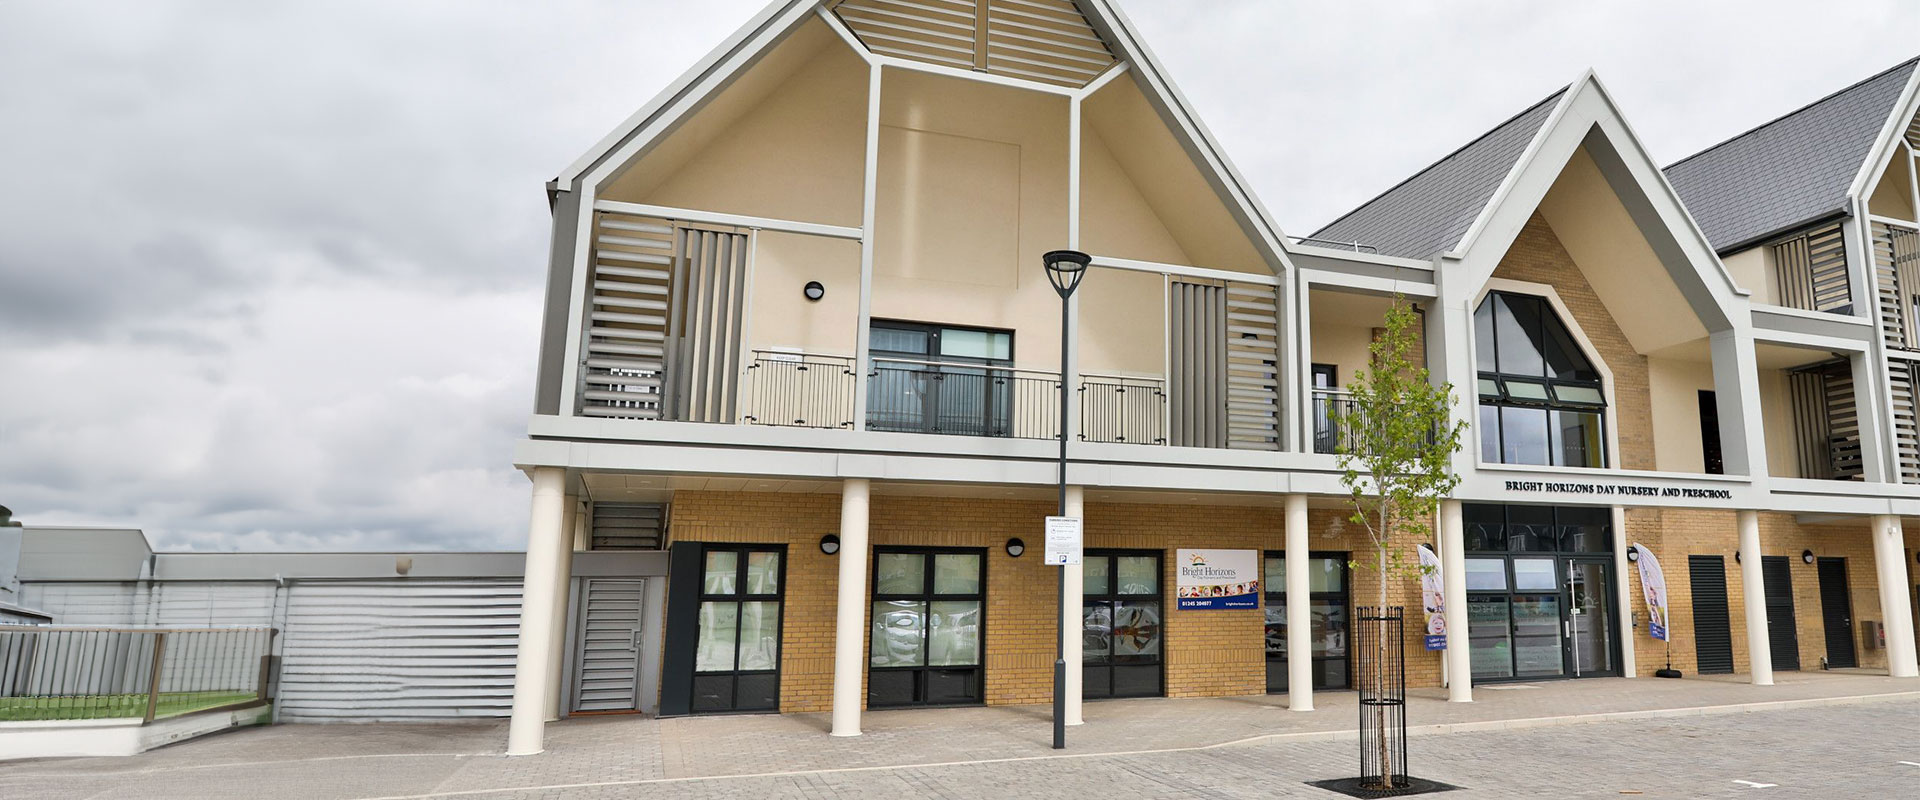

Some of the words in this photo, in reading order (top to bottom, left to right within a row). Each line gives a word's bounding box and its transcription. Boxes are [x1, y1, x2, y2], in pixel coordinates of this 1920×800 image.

[1505, 481, 1543, 492] BRIGHT
[1545, 482, 1594, 494] HORIZONS
[1596, 484, 1616, 495] DAY
[1617, 485, 1659, 497] NURSERY
[1661, 487, 1681, 497] AND
[1682, 488, 1732, 499] PRESCHOOL
[1182, 566, 1203, 578] Bright
[1205, 567, 1236, 576] Horizons
